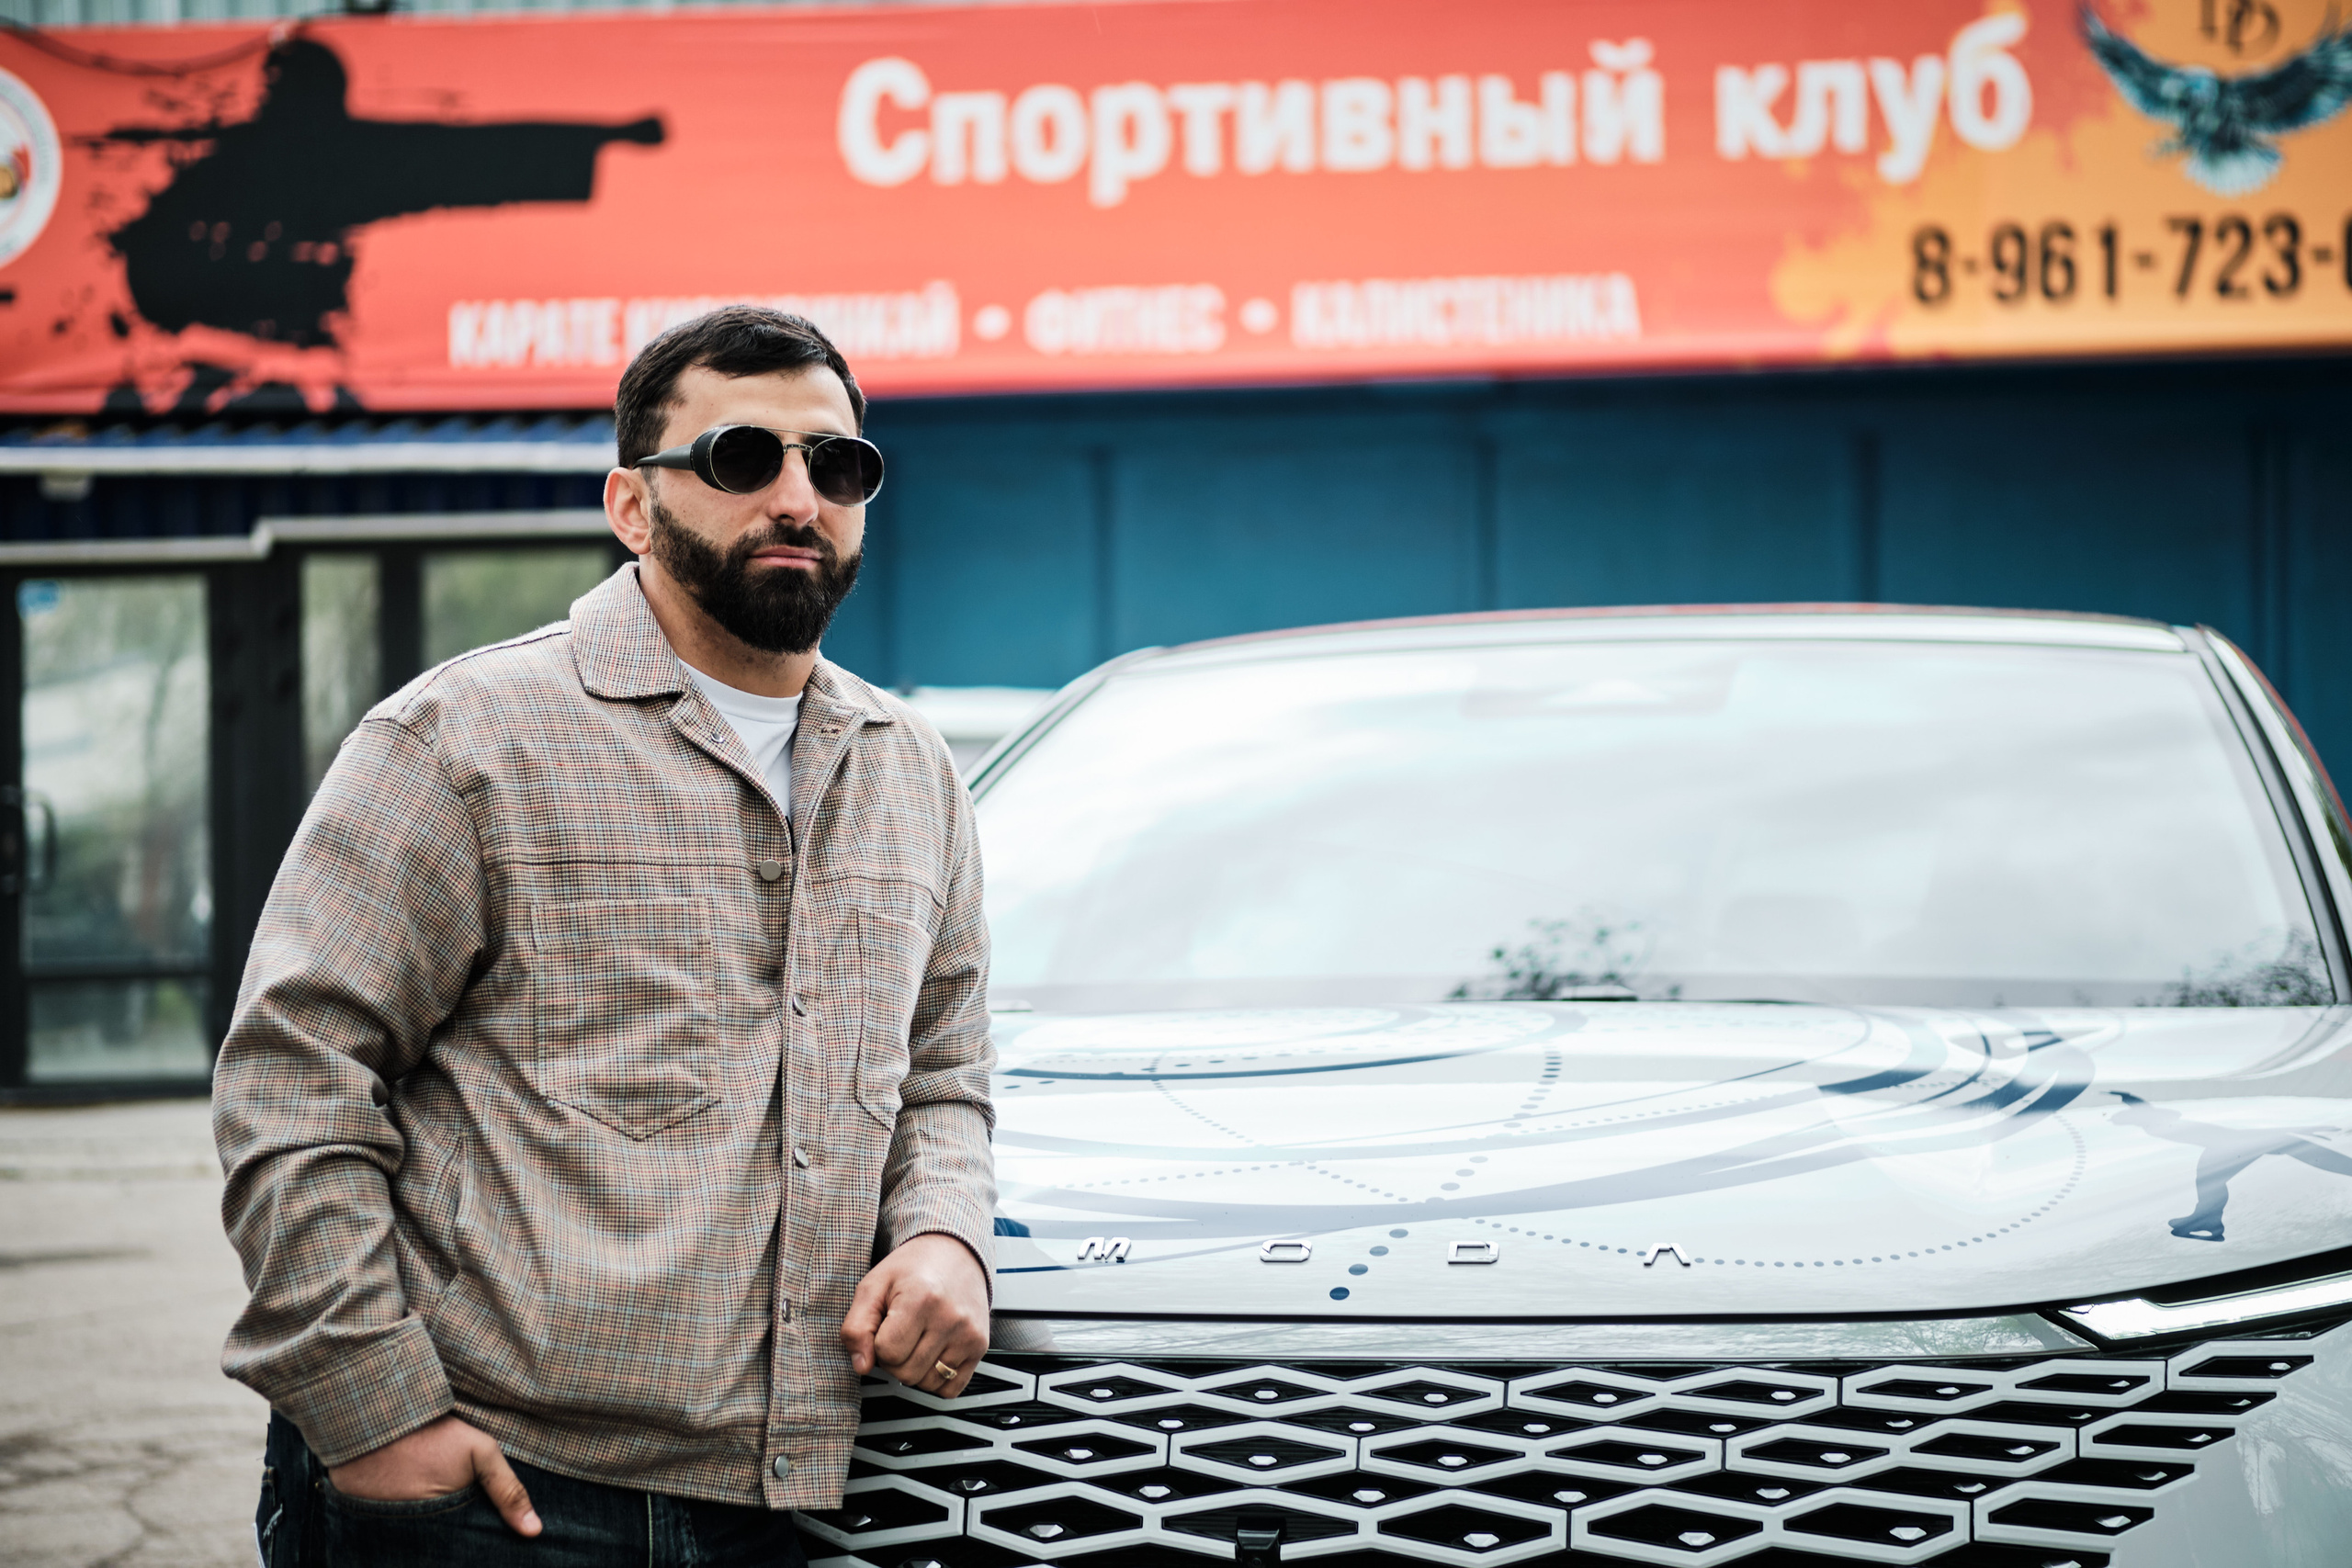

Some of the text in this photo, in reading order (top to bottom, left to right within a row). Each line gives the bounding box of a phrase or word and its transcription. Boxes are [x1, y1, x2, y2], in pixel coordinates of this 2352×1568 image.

[837, 13, 2032, 209] Спортивный клуб
[1913, 212, 2352, 306] 8-961-723-
[448, 298, 621, 367] КАРАТЕ
[1023, 283, 1227, 355] ФИТНЕС
[1290, 273, 1643, 348] КАЛИСТЕНИКА
